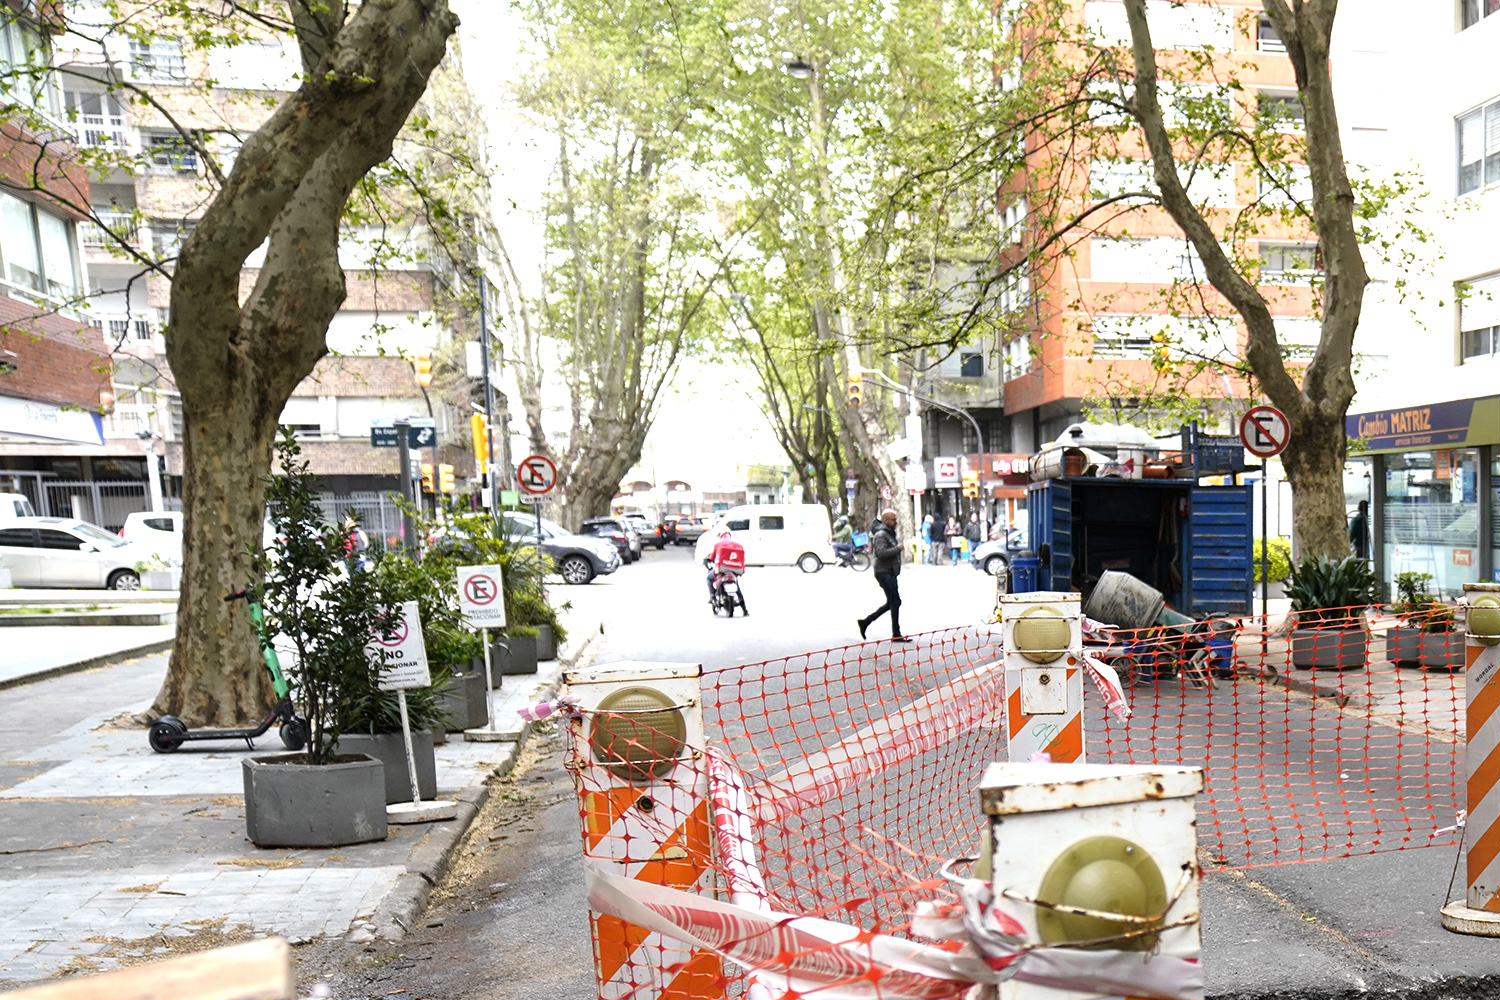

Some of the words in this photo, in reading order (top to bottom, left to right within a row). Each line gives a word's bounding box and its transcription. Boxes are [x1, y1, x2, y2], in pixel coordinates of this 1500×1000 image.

[1358, 412, 1389, 438] Cambio
[1390, 408, 1432, 434] MATRIZ
[386, 649, 404, 660] NO
